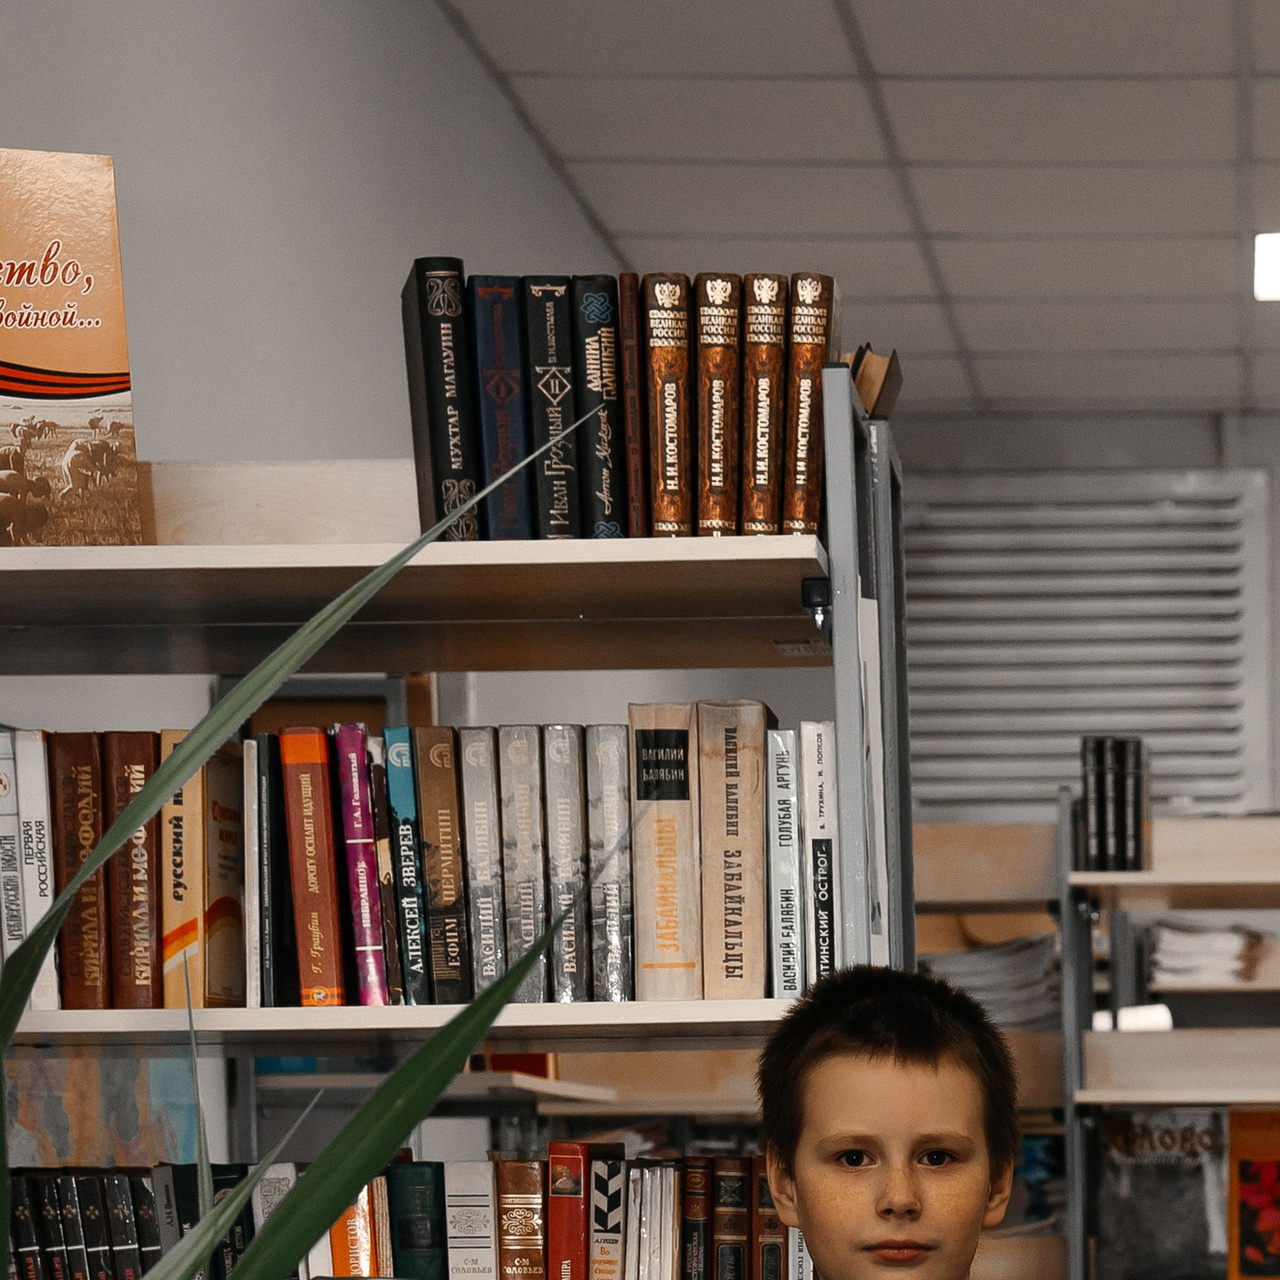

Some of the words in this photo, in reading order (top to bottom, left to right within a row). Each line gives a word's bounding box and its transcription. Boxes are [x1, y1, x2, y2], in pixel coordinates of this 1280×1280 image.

[441, 322, 458, 398] МАГАУИН
[447, 405, 463, 470] МУХТАР
[642, 748, 684, 762] ВАСИЛИЙ
[642, 768, 685, 782] БАЛЯБИН
[724, 726, 741, 779] ВАСИЛИЙ
[775, 749, 791, 790] АРГУНЬ
[124, 764, 149, 882] МЕФИЙ
[299, 772, 315, 815] ИДУЩИЙ
[725, 782, 740, 837] БАЛЯБИН
[777, 798, 792, 848] ГОЛУБАЯ
[22, 820, 34, 866] ПЕРВАЯ
[34, 820, 47, 898] РОССИЙСКАЯ
[303, 816, 317, 860] ОСИЛИТ
[398, 824, 417, 888] ЗВЕРЕВ
[438, 808, 457, 905] ПЕРМИТИН
[473, 800, 493, 882] БАЛЯБИН
[306, 860, 320, 894] ДОРОГУ
[400, 896, 425, 974] АЛЕКСЕЙ
[444, 918, 461, 967] ЕФИМ
[476, 896, 497, 977] ВАСИЛИЙ
[517, 881, 535, 951] АСИЛИЙ
[558, 892, 577, 974] ВАСИЛЙ
[722, 849, 744, 980] ЗАБАЙКАЛЬЦЫ
[131, 908, 151, 986] КИРИЛЛ
[816, 909, 832, 982] ИТИНСКИЙ
[346, 1216, 362, 1276] ЮРИСТОВ
[450, 1266, 493, 1275] СОЛОВЬЕВ
[502, 1266, 544, 1275] СОЛОВЬЕВ
[561, 1259, 572, 1280] МИРА
